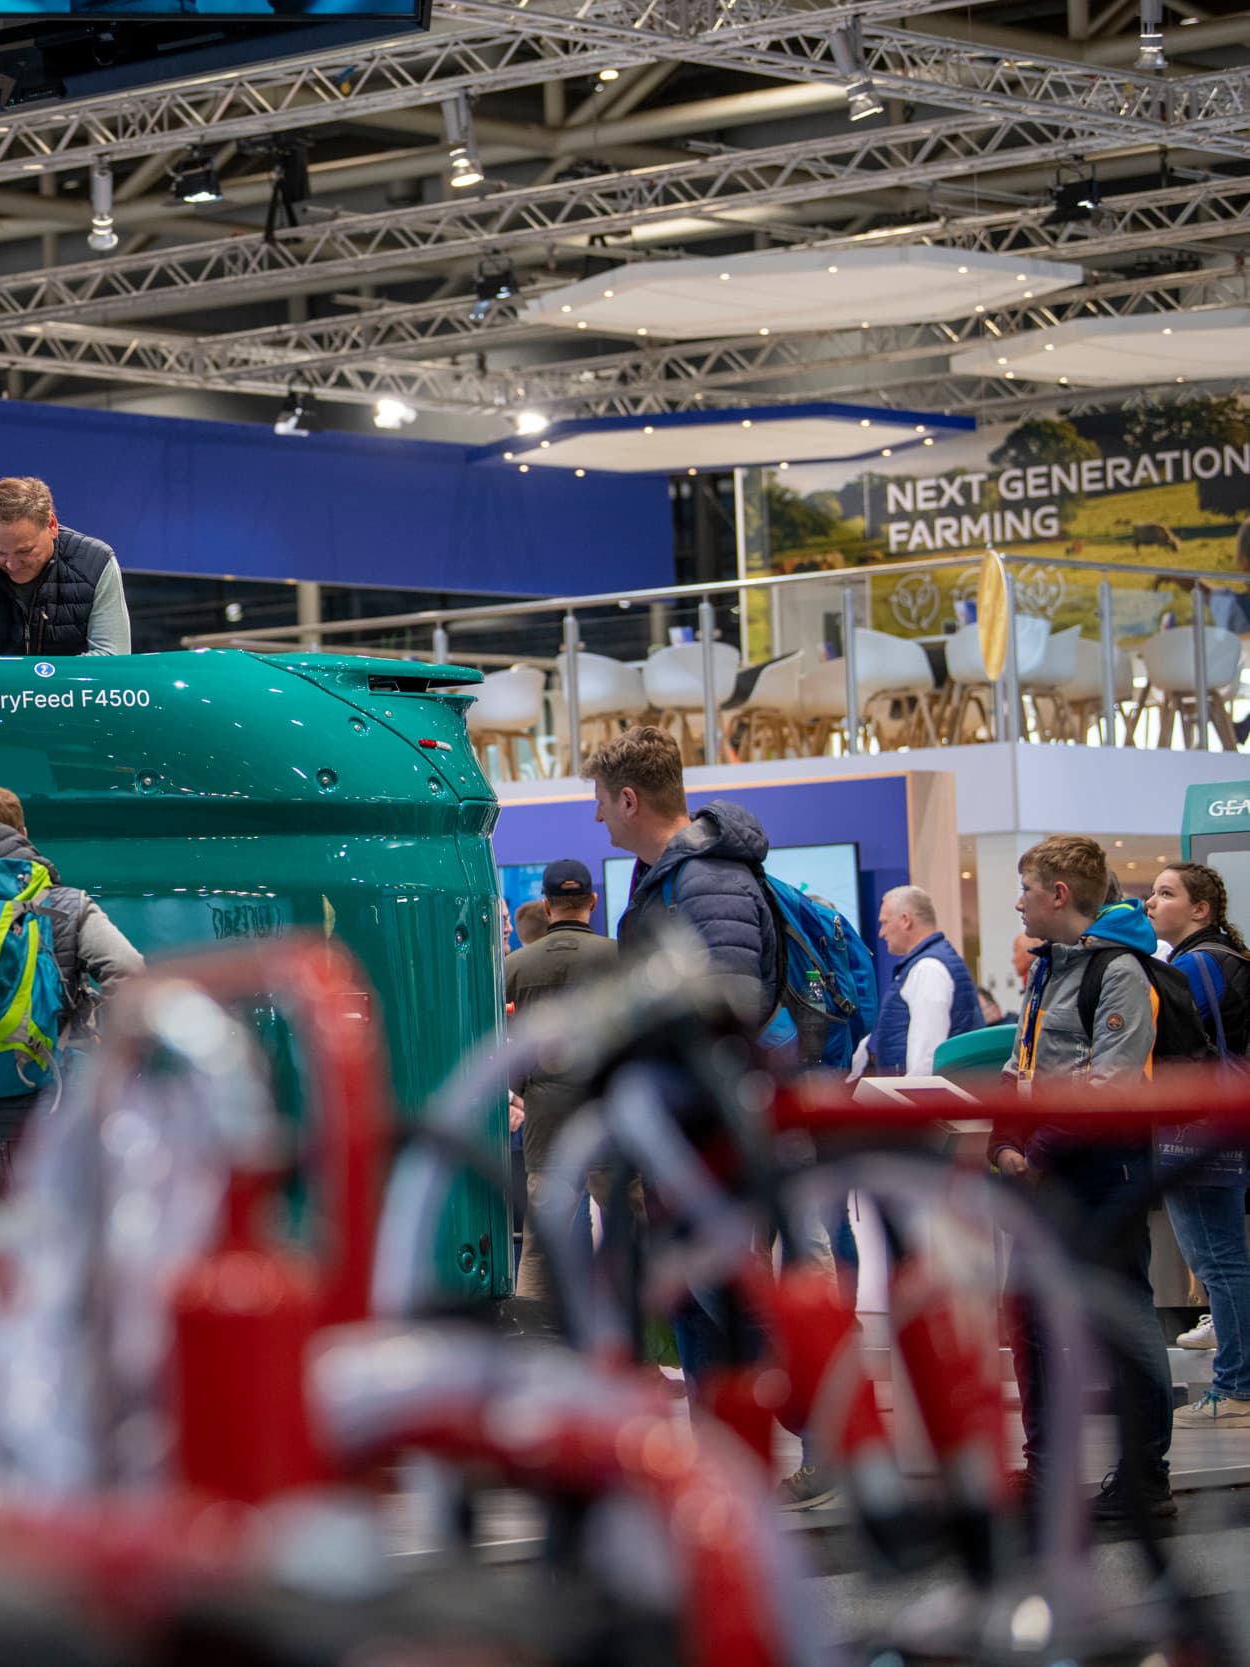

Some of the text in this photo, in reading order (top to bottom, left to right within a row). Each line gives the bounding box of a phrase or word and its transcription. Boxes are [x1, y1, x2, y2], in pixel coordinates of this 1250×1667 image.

[886, 444, 1250, 514] NEXT GENERATION
[888, 505, 1059, 553] FARMING
[81, 689, 150, 708] F4500
